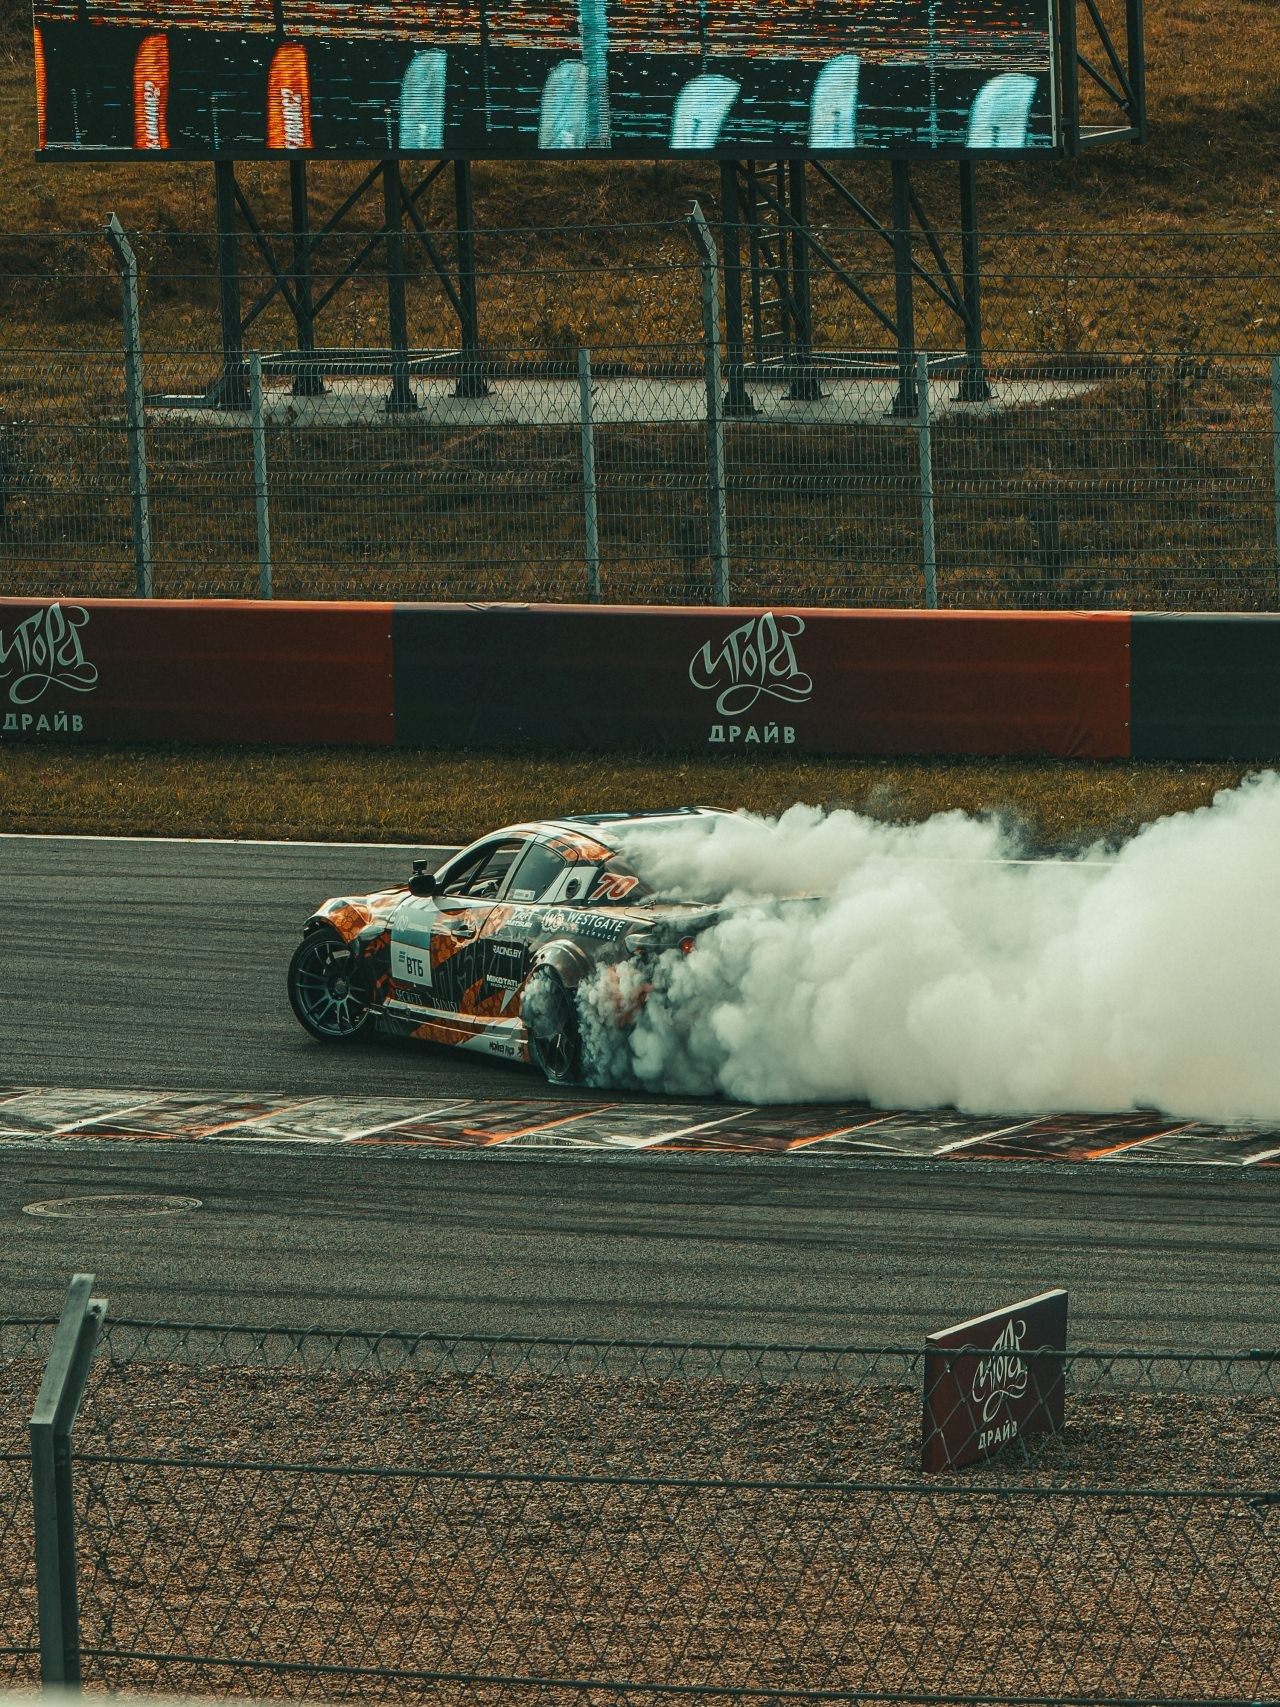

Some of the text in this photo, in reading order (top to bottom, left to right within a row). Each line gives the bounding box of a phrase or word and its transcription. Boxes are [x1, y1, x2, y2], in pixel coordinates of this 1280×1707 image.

[3, 711, 83, 732] ДРАЙВ
[708, 721, 796, 743] ДРАЙВ
[588, 872, 639, 900] 70
[566, 911, 626, 932] WESTGATE
[406, 956, 424, 977] ВТБ
[978, 1419, 1018, 1450] ДРАЙВ
